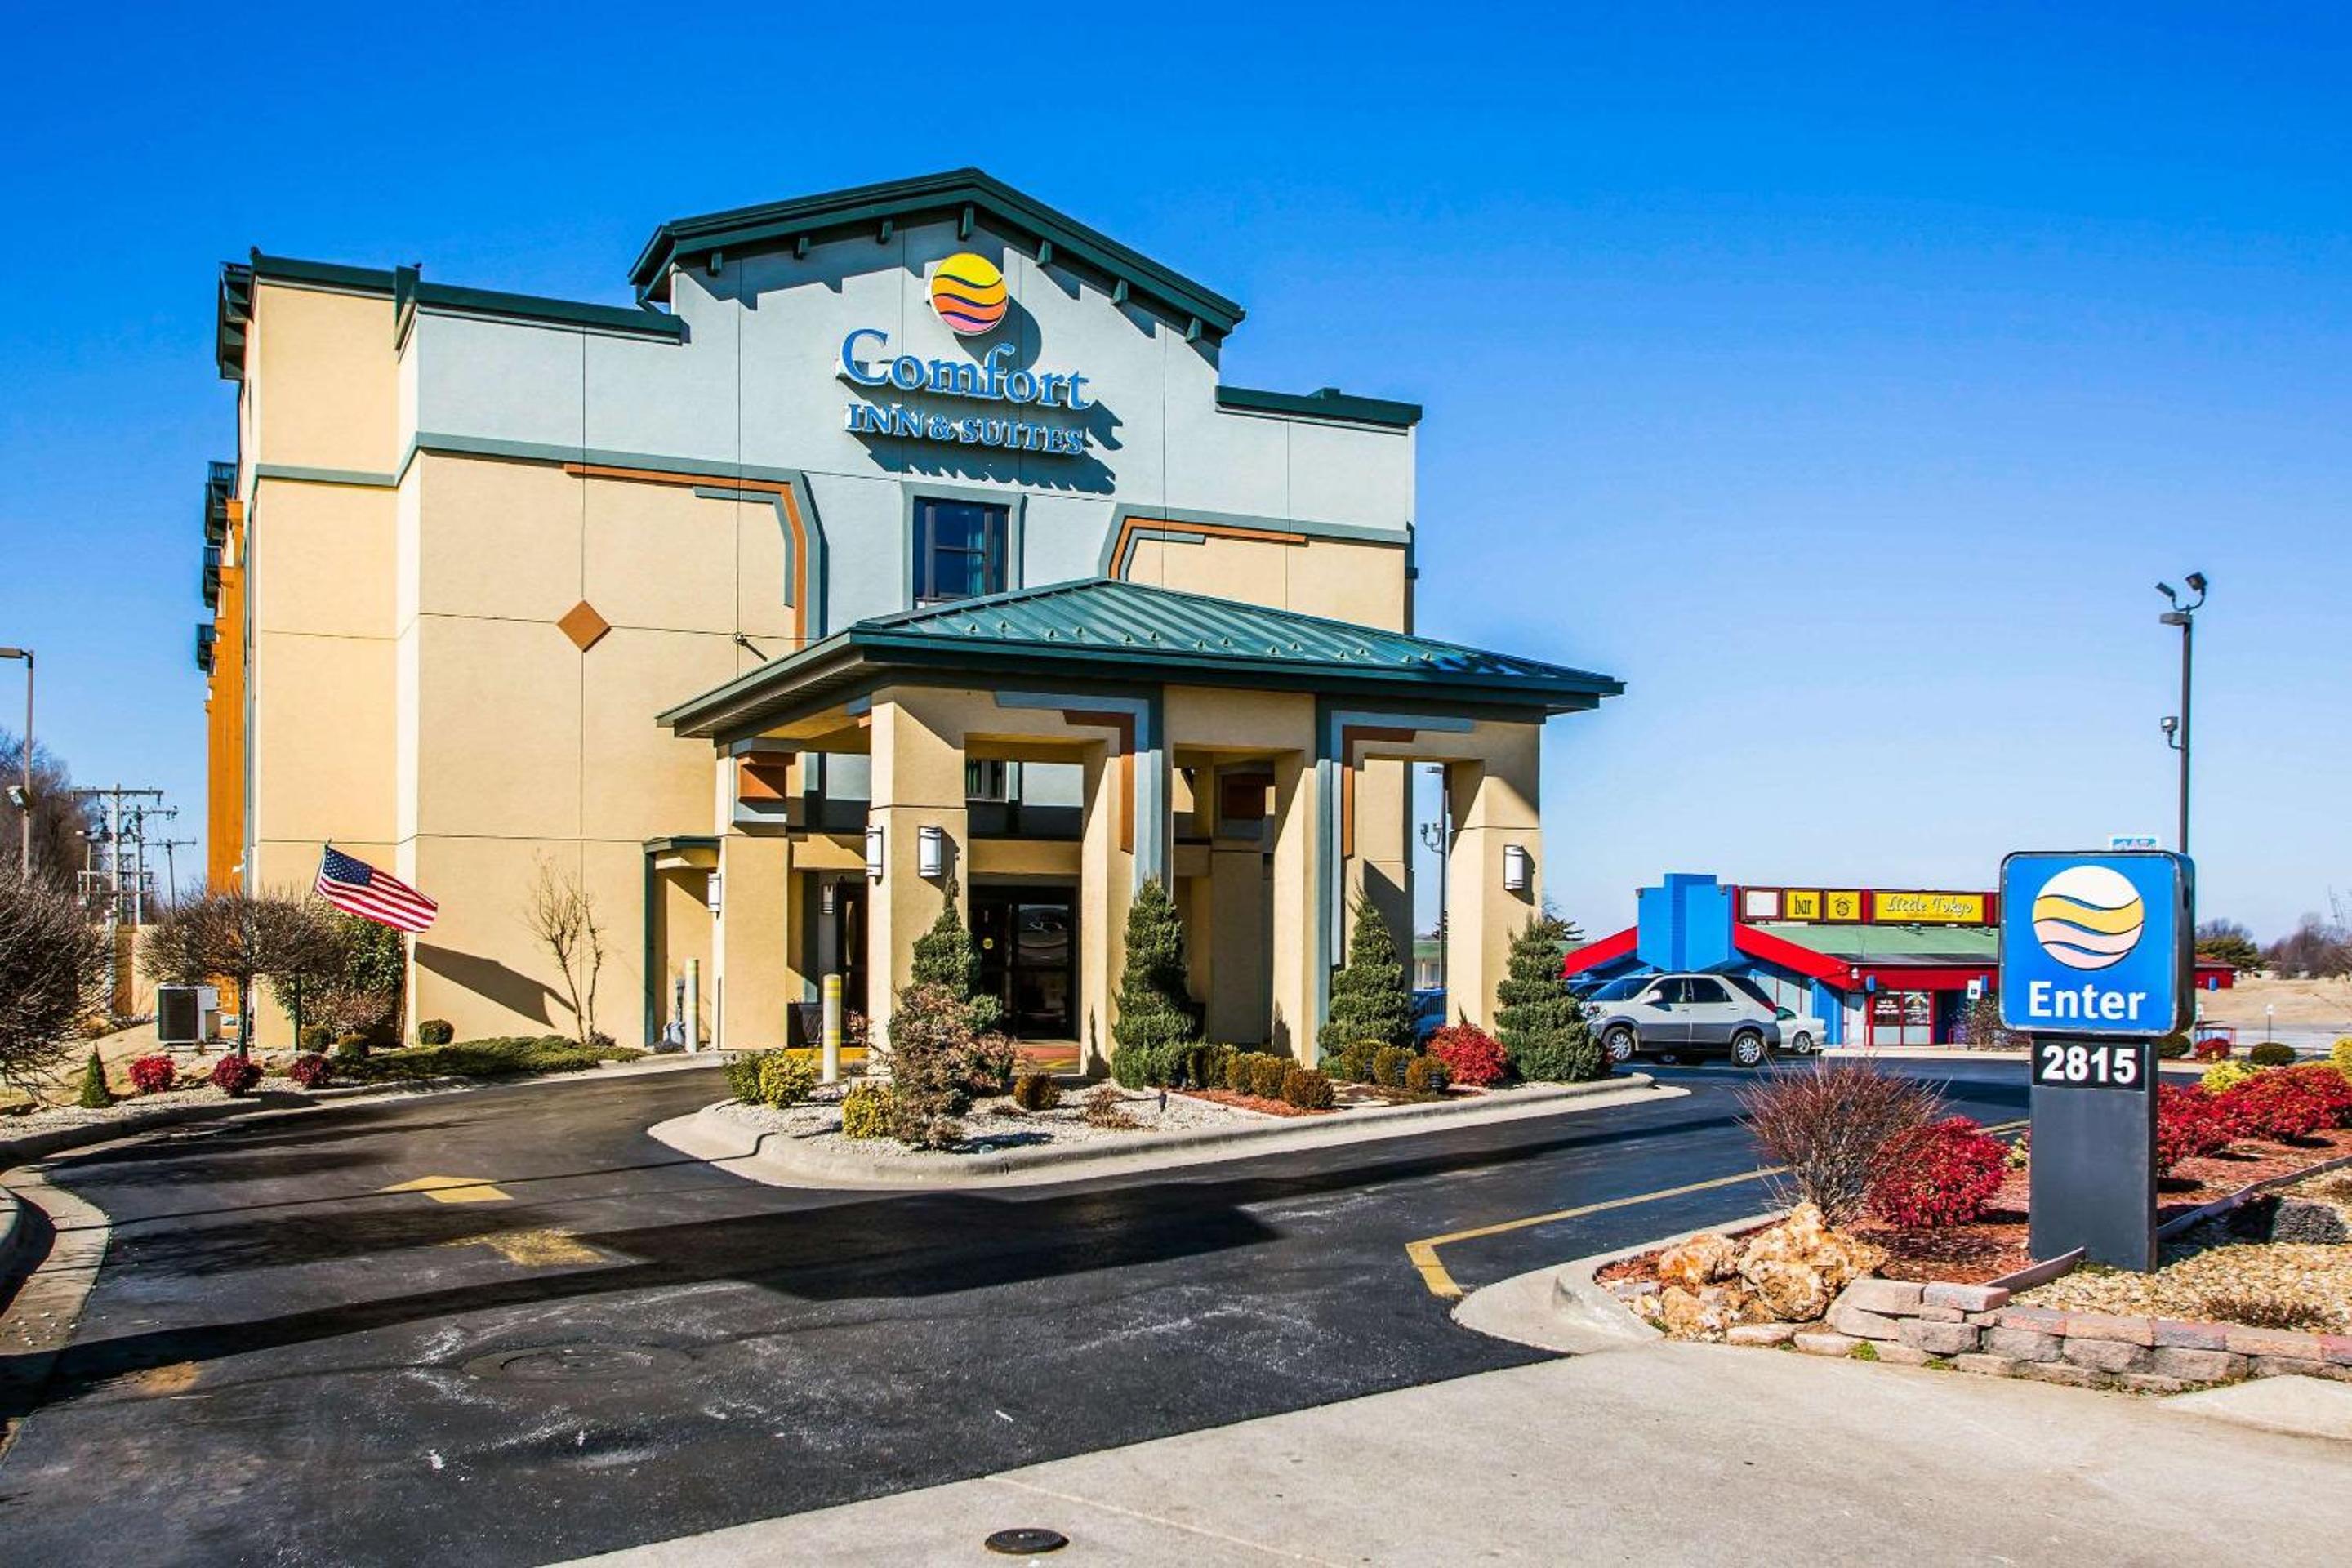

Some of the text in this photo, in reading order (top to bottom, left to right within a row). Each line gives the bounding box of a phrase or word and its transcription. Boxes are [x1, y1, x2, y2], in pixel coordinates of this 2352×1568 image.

[840, 328, 1091, 409] Comfort
[846, 403, 1084, 455] INN & SUITES
[1794, 895, 1811, 915] bar
[1886, 896, 1973, 917] Little Tokyo
[2029, 981, 2146, 1020] Enter
[2042, 1045, 2136, 1084] 2815
